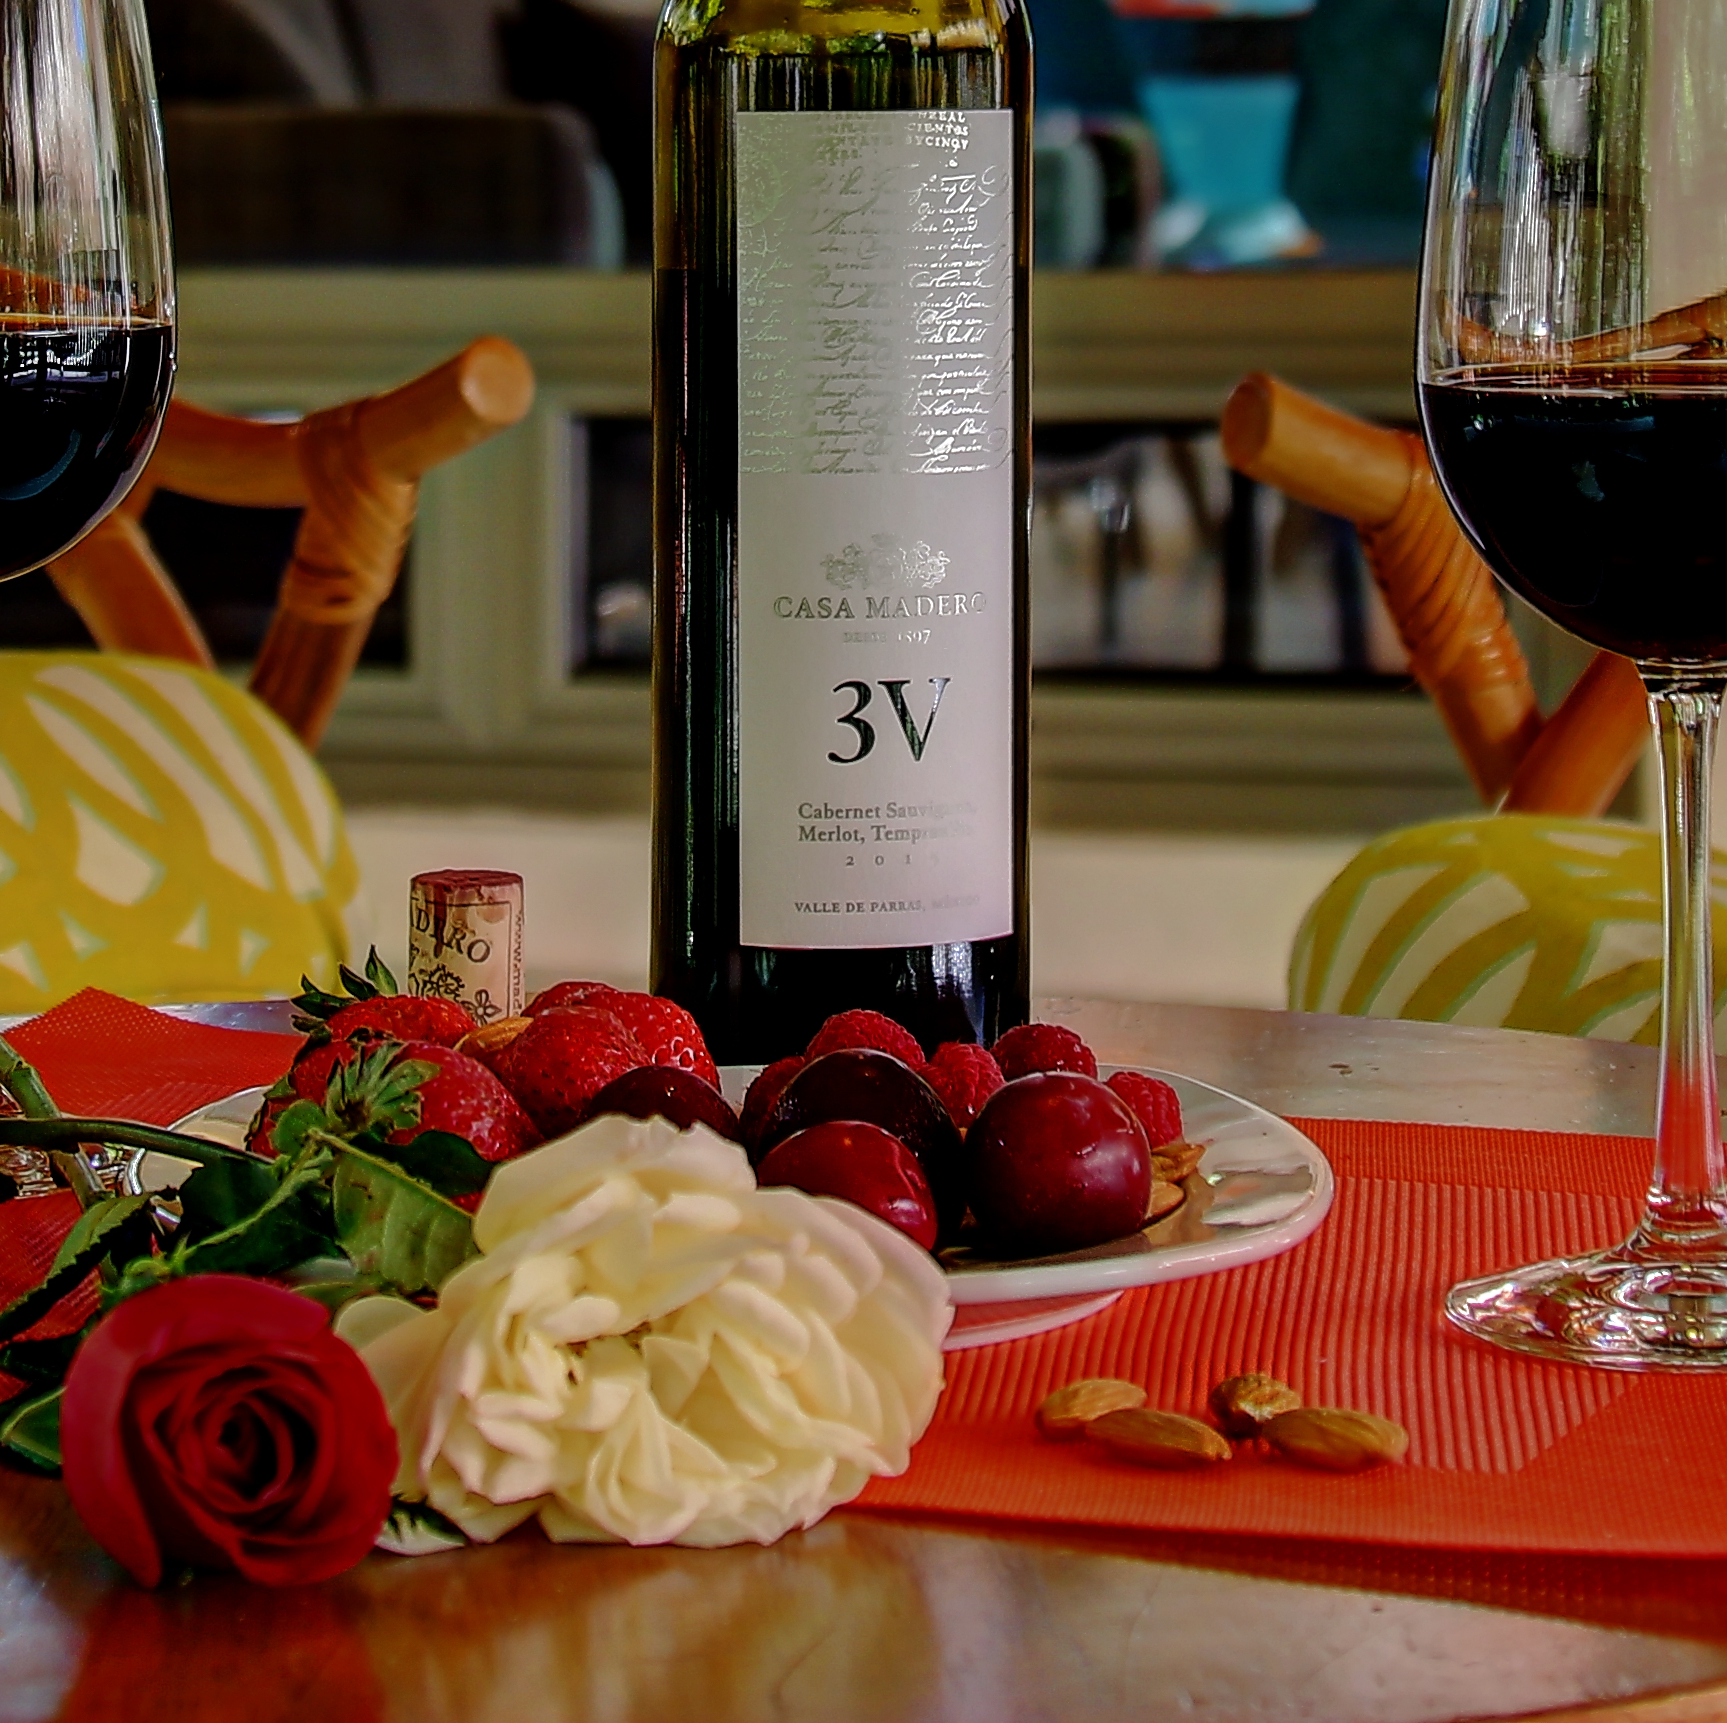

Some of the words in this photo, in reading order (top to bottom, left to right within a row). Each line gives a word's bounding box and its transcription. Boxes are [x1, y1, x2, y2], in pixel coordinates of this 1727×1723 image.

[774, 594, 856, 619] CASA
[865, 591, 986, 619] MADERO
[826, 676, 953, 765] 3V
[797, 802, 881, 819] Cabernet
[798, 824, 866, 844] Merlot,
[795, 902, 841, 914] VALLE
[846, 902, 866, 914] DE
